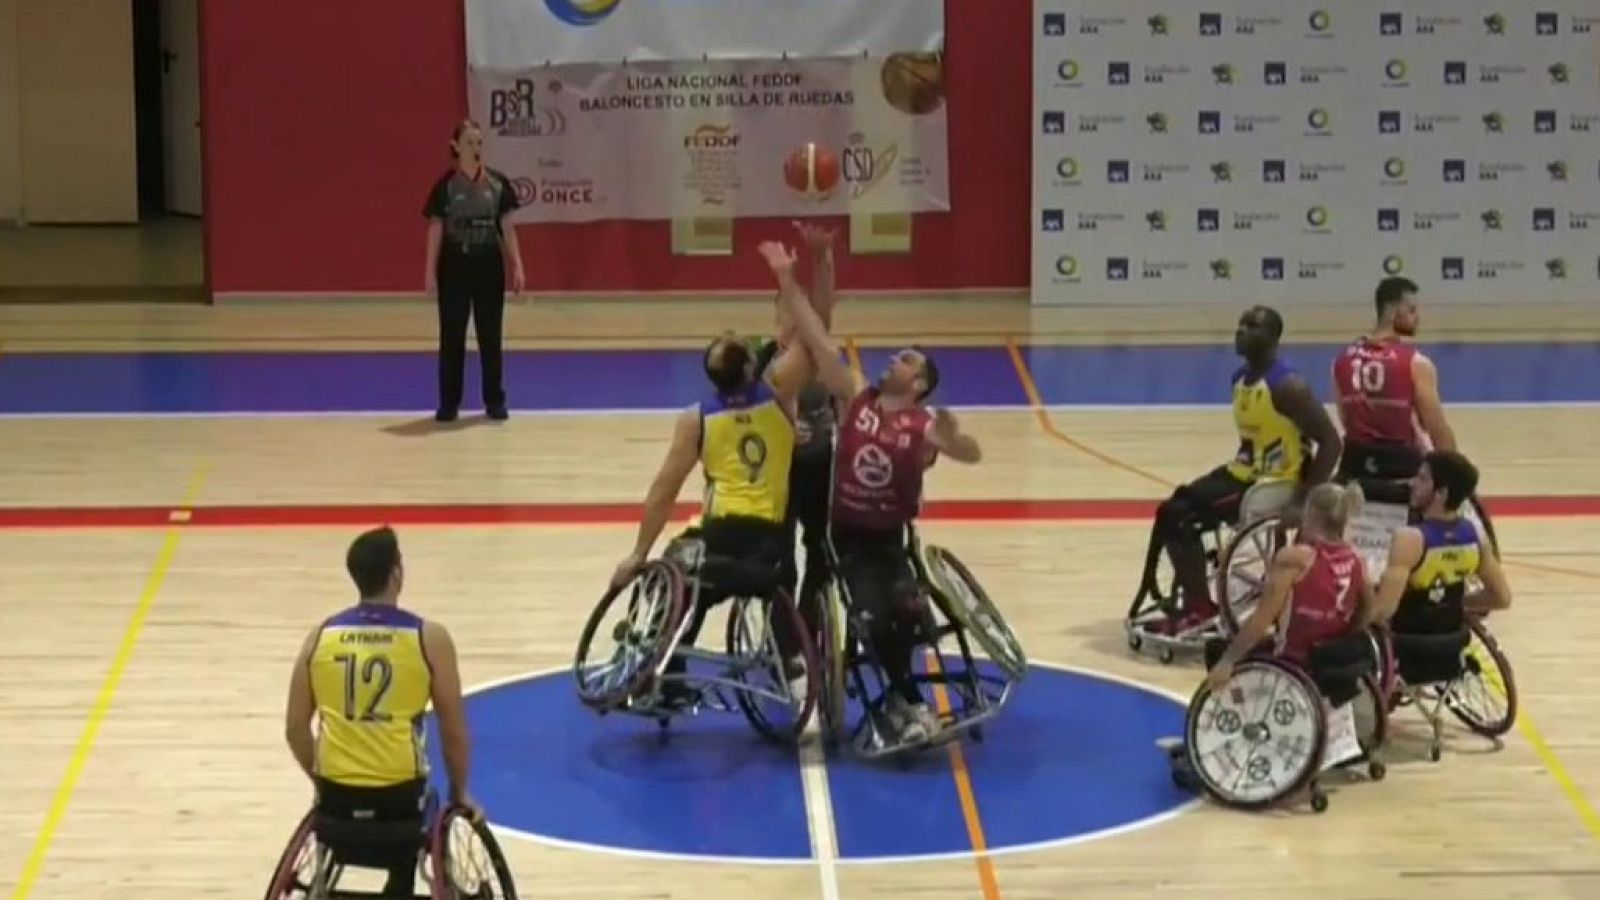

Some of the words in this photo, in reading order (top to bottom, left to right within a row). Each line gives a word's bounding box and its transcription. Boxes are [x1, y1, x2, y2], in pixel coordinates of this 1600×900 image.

[627, 76, 664, 91] LIGA
[668, 74, 748, 89] NACIONAL
[579, 94, 688, 112] BALONCESTO
[690, 93, 712, 107] EN
[716, 92, 760, 107] SILLA
[764, 91, 784, 106] DE
[788, 91, 854, 106] RUEDAS
[541, 188, 593, 204] ONCE
[1351, 358, 1386, 393] 10
[739, 432, 767, 484] 9
[1333, 575, 1352, 612] 7
[333, 653, 394, 721] 12
